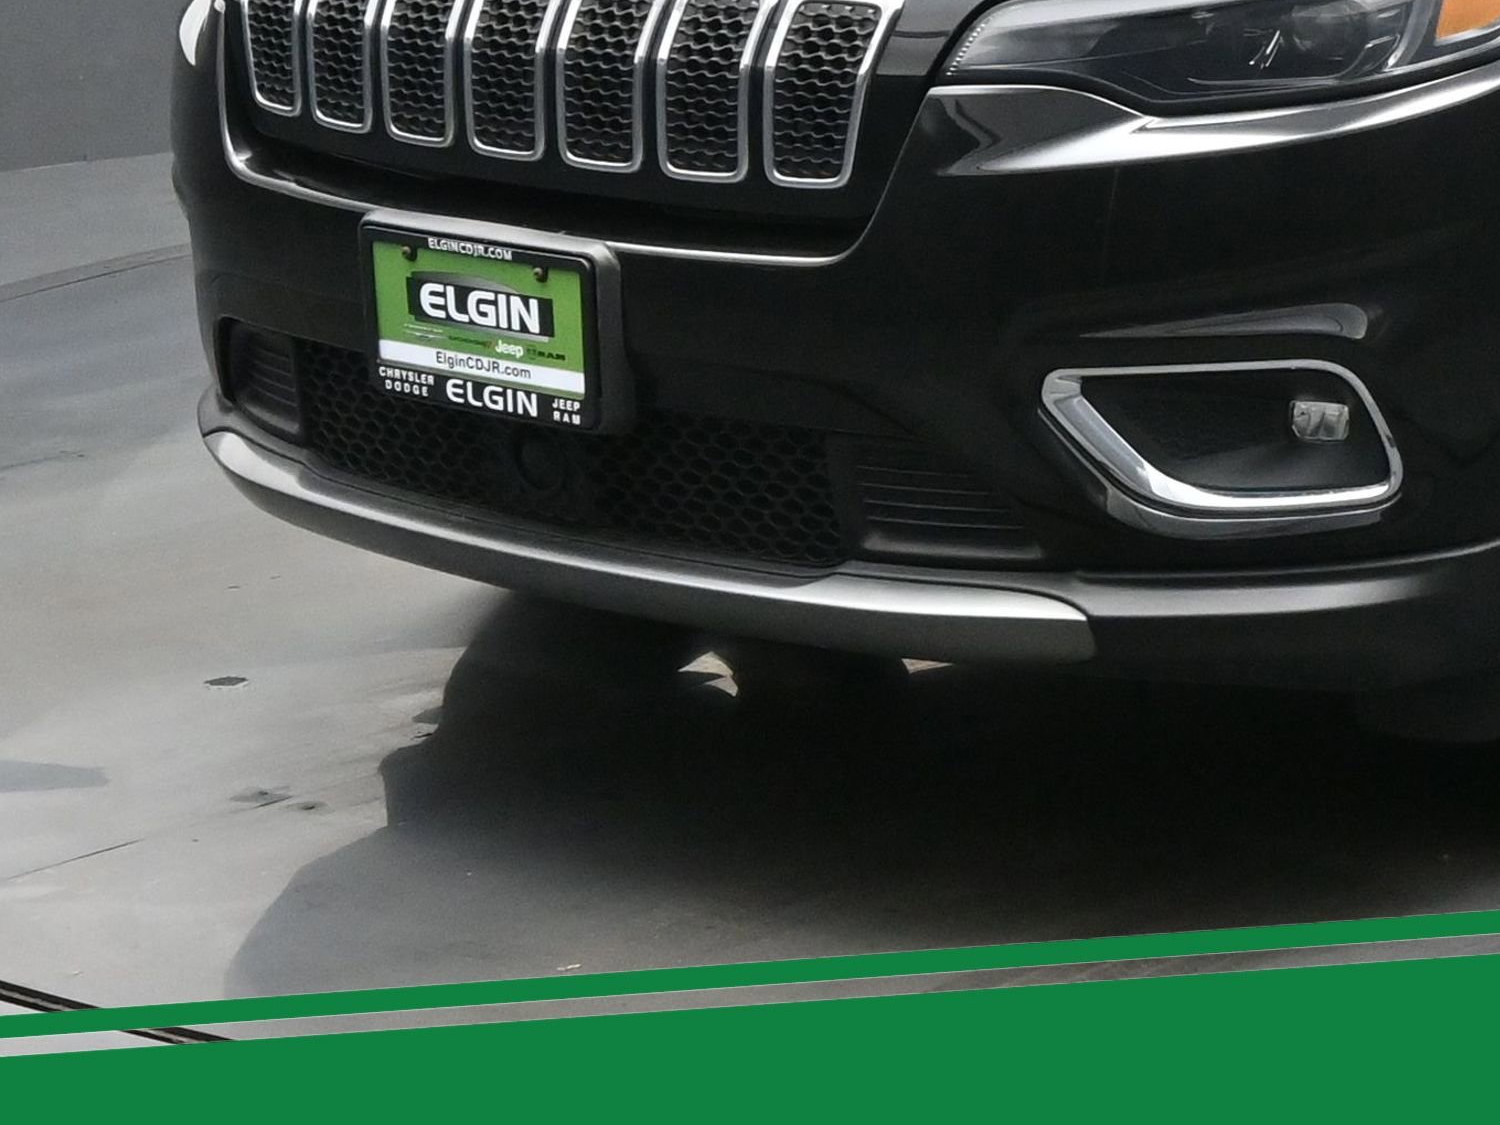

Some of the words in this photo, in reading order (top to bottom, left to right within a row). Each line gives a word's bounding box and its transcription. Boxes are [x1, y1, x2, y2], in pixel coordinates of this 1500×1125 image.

[427, 237, 512, 261] ELGINCDJR.COM
[419, 281, 540, 334] ELGIN
[494, 339, 524, 358] Jeep
[435, 351, 531, 379] ElginCDJR.com
[378, 366, 434, 386] CHRYSLER
[385, 379, 429, 397] DODGE
[446, 378, 538, 418] ELGIN
[552, 398, 580, 412] JEEP
[553, 410, 580, 425] RAM
